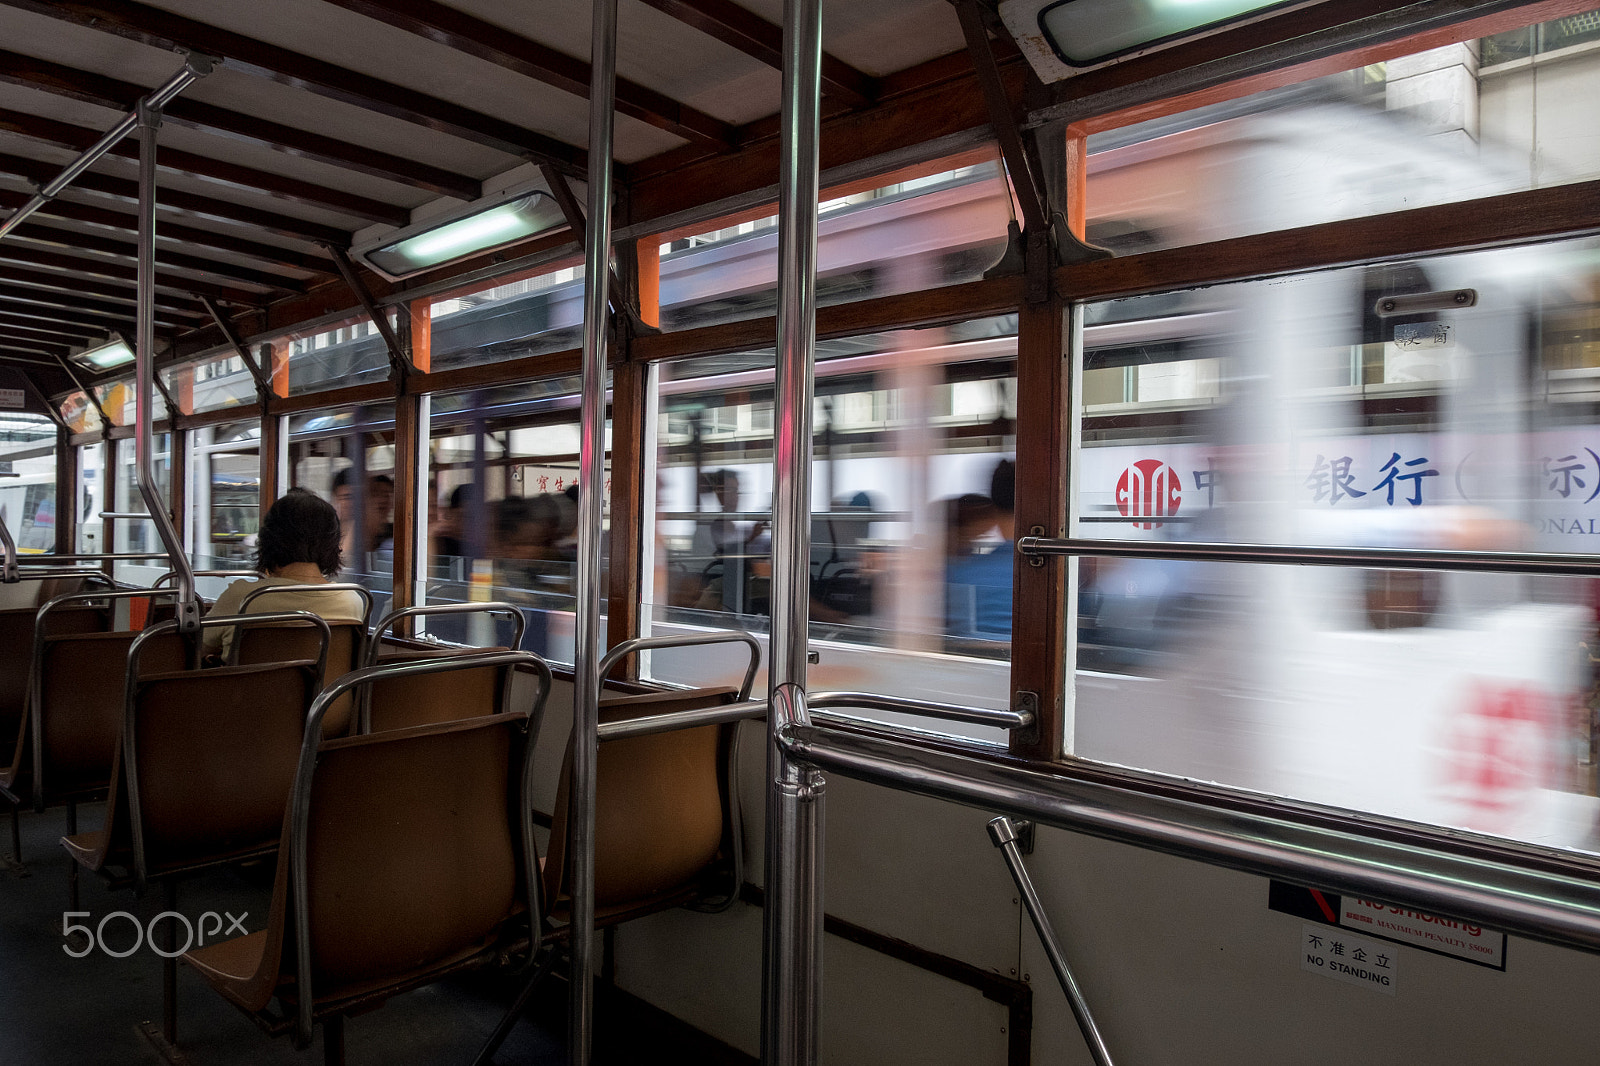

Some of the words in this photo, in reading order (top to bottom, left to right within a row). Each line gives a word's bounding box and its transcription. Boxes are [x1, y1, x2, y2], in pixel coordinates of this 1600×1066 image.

[1376, 919, 1423, 937] MAXIMUM
[1424, 931, 1467, 949] PENALTY
[1308, 934, 1391, 969] 不准企立
[1306, 953, 1324, 967] NO
[1329, 960, 1390, 986] STANDING
